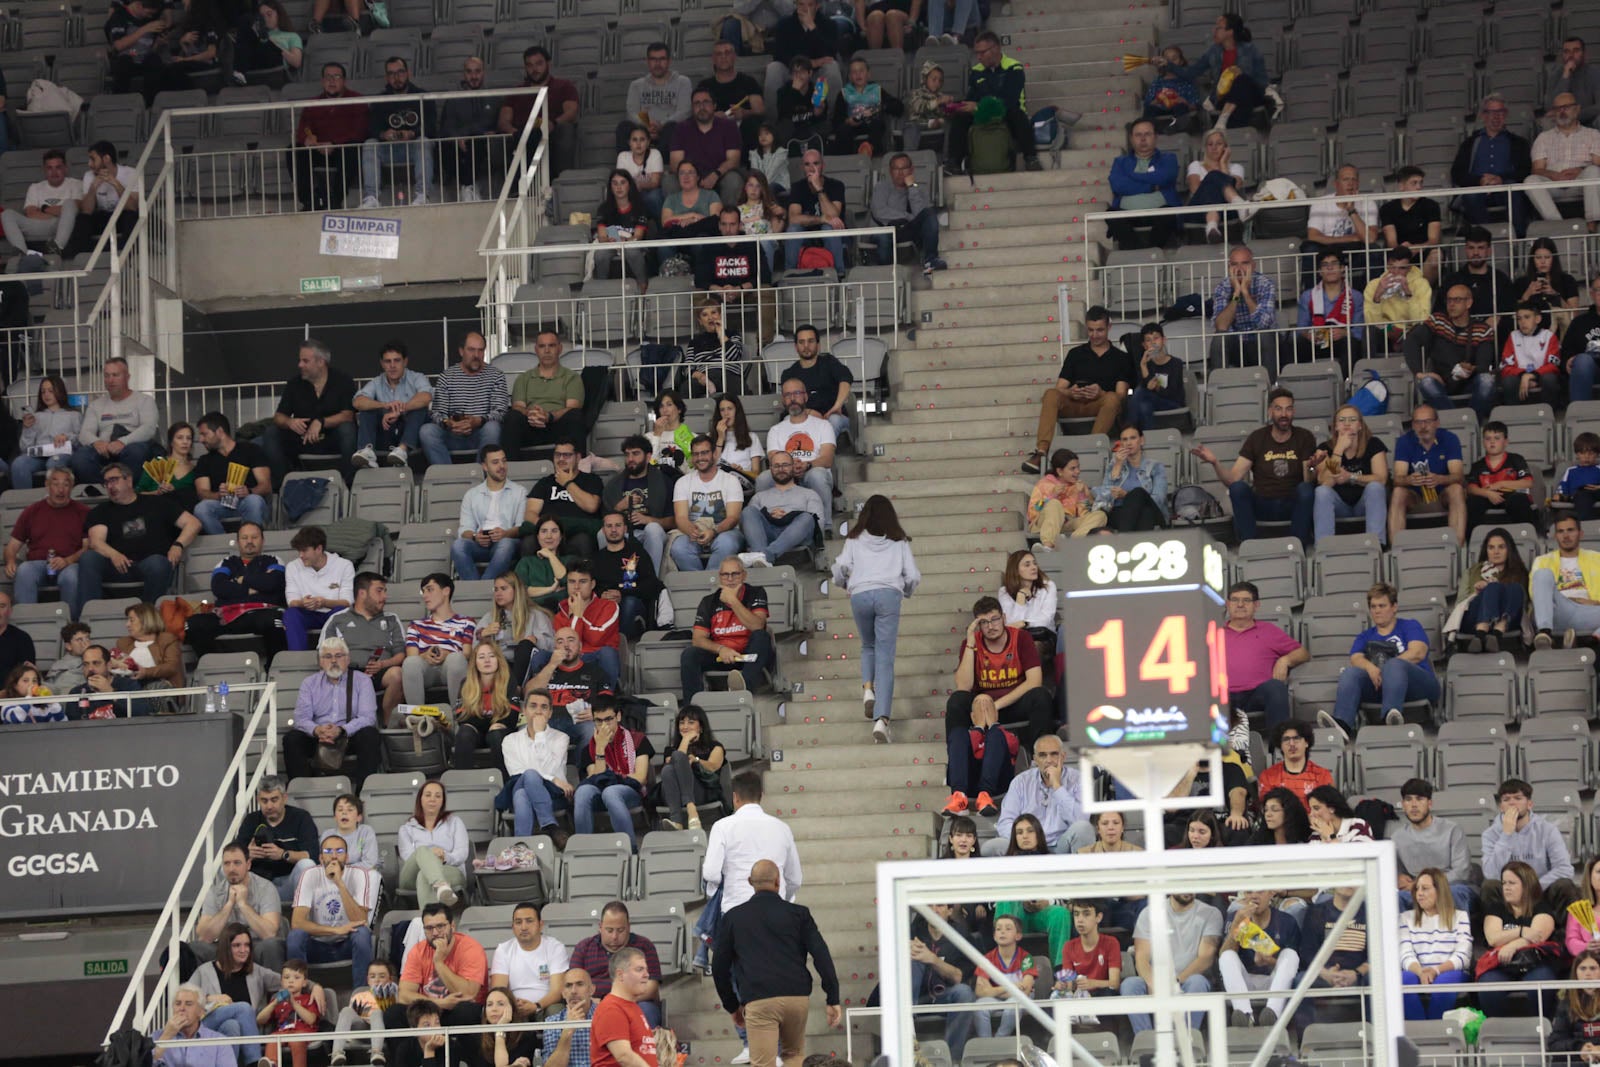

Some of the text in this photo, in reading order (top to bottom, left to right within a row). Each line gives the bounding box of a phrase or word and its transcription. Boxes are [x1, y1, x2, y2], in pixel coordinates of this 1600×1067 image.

[327, 218, 395, 233] D3 IMPAR
[716, 267, 749, 277] JONES
[303, 278, 338, 290] SALIDA
[874, 445, 884, 455] 11
[693, 491, 722, 501] VOYAGE
[1087, 540, 1188, 584] 8:28
[816, 621, 825, 631] 8
[1085, 615, 1197, 698] 14
[794, 682, 802, 692] 7
[773, 751, 781, 761] 6
[0, 805, 158, 837] GRANADA
[86, 961, 125, 974] SALIDA
[705, 965, 713, 976] 3
[680, 1043, 689, 1053] 2
